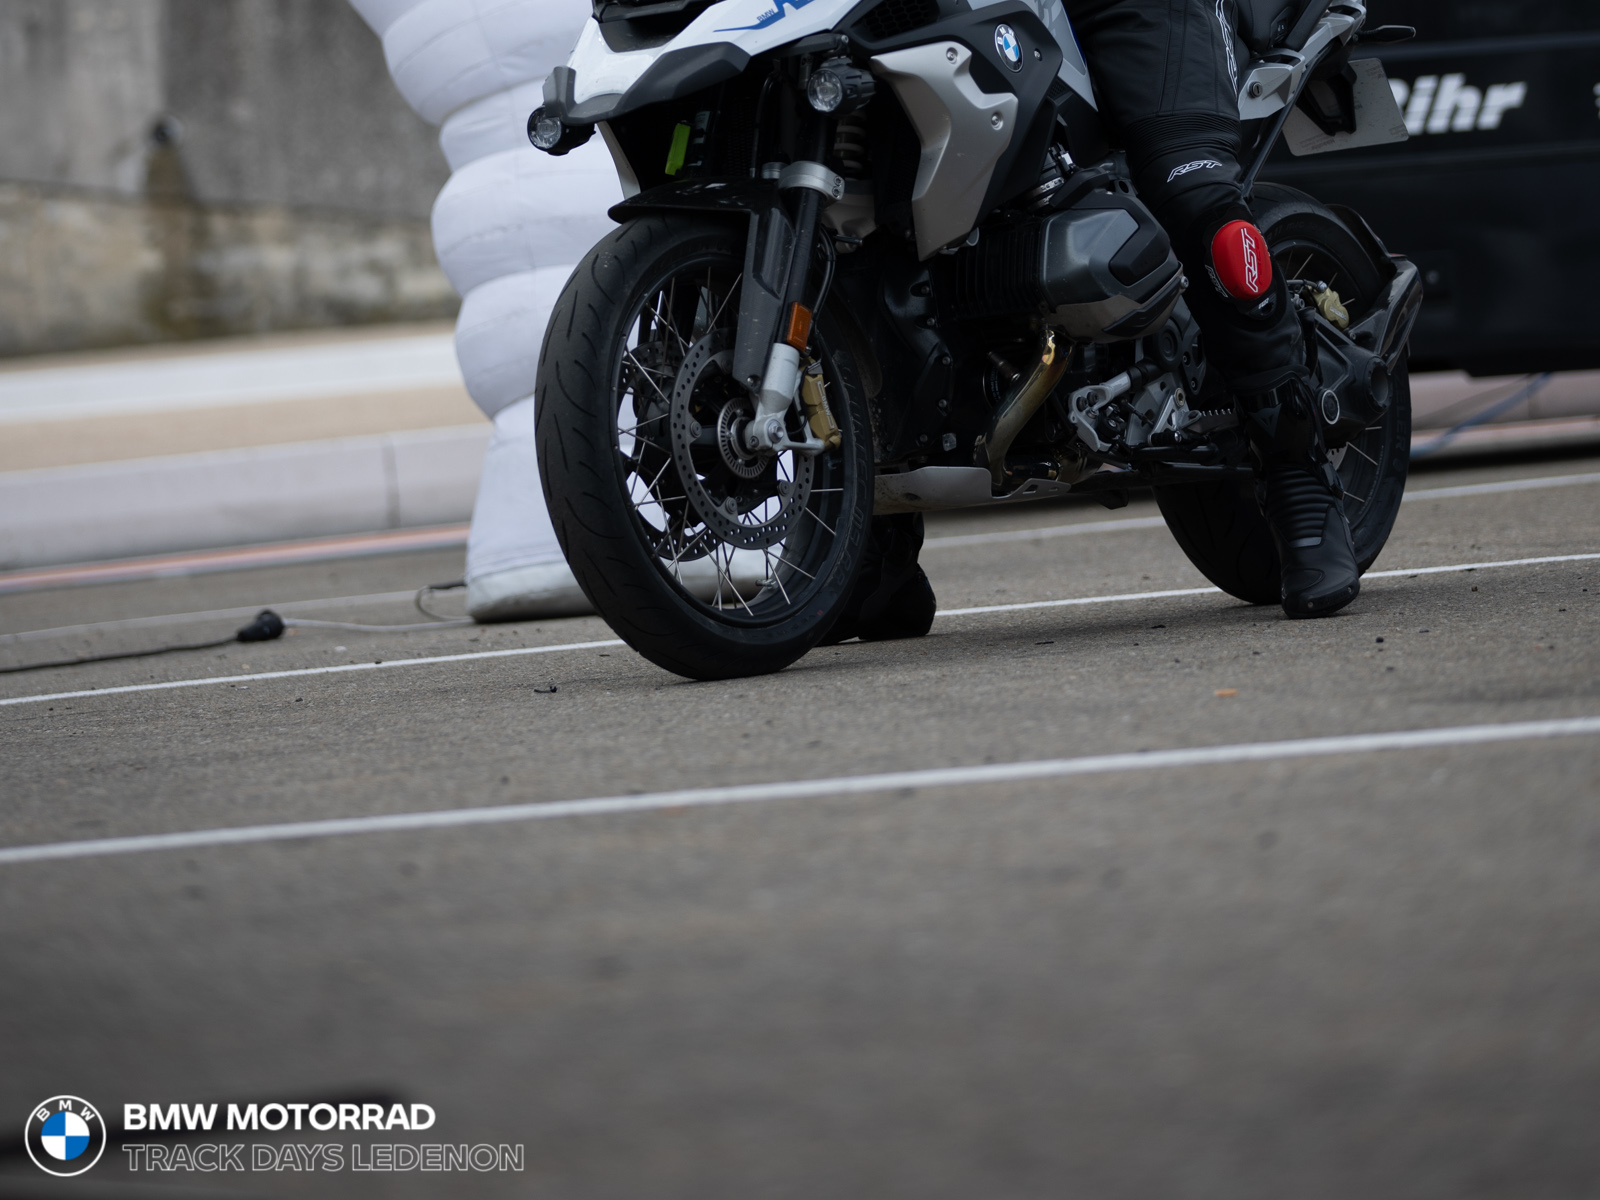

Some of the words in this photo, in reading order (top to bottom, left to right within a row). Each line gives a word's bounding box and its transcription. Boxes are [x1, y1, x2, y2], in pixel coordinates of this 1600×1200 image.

[756, 8, 775, 22] BMW
[1166, 159, 1223, 183] RST
[1240, 227, 1259, 294] RST
